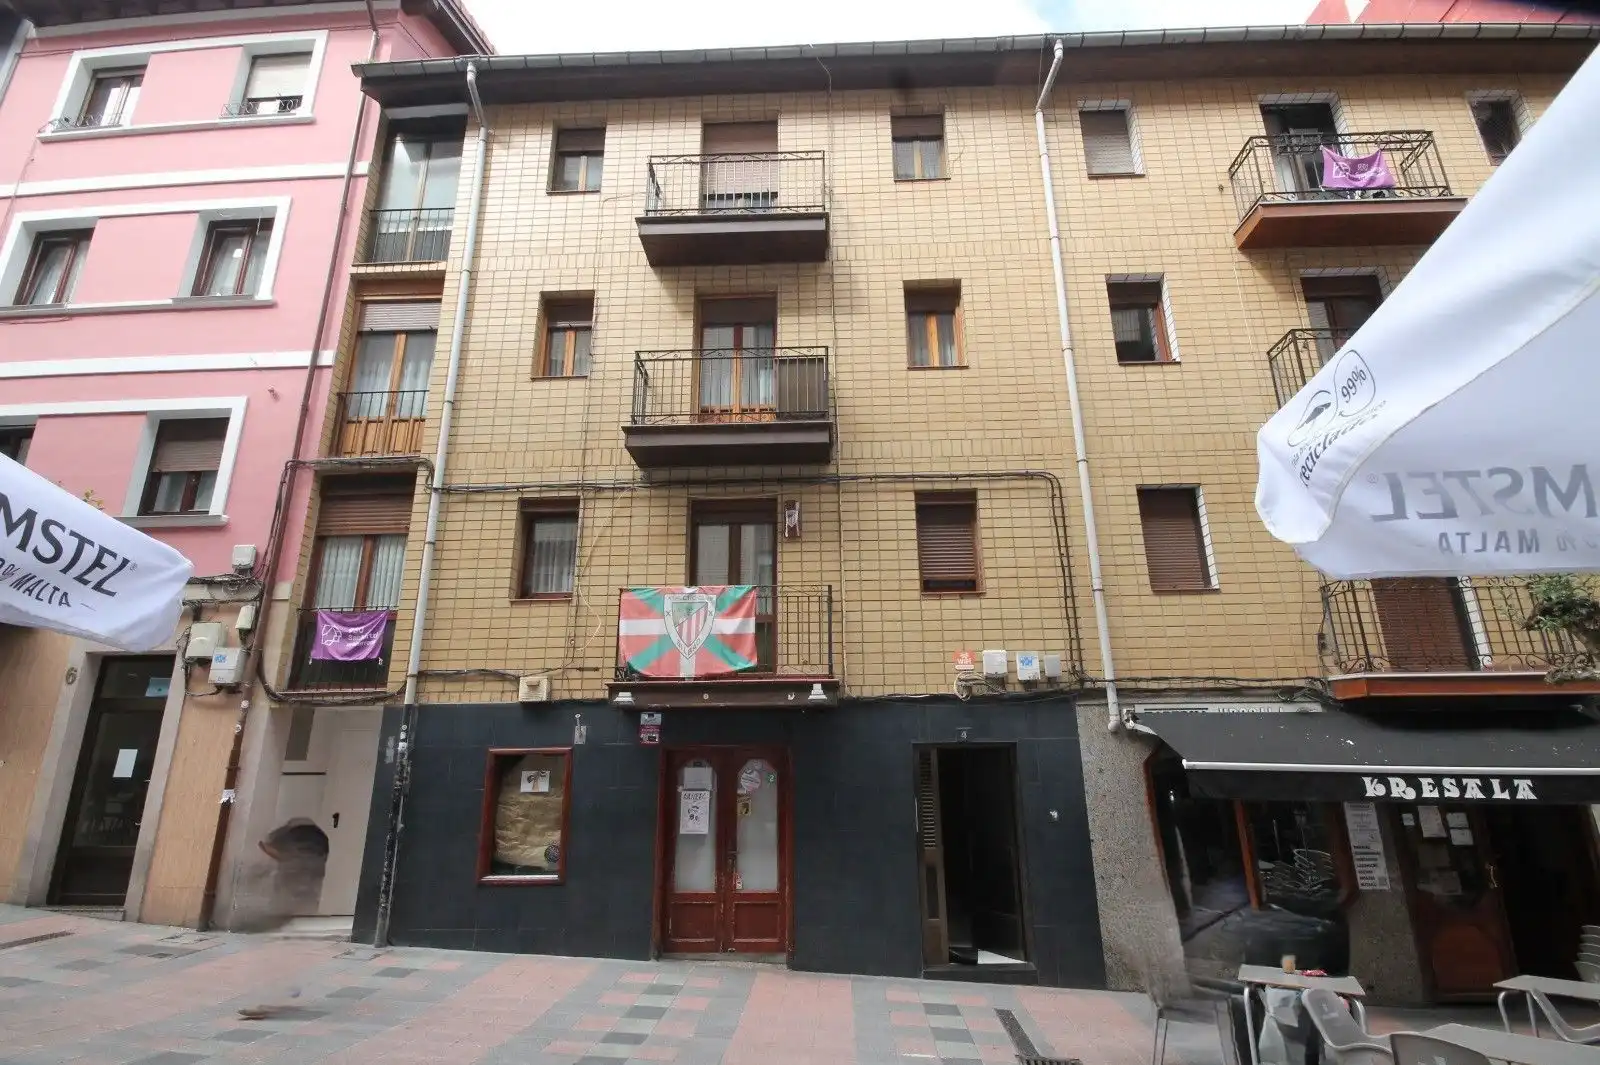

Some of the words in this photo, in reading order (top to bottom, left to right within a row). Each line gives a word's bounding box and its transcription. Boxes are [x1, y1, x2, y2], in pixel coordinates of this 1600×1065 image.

[1341, 364, 1367, 403] 99%
[9, 573, 71, 608] MALTA
[66, 667, 77, 685] 6
[1361, 776, 1538, 800] KRESALA
